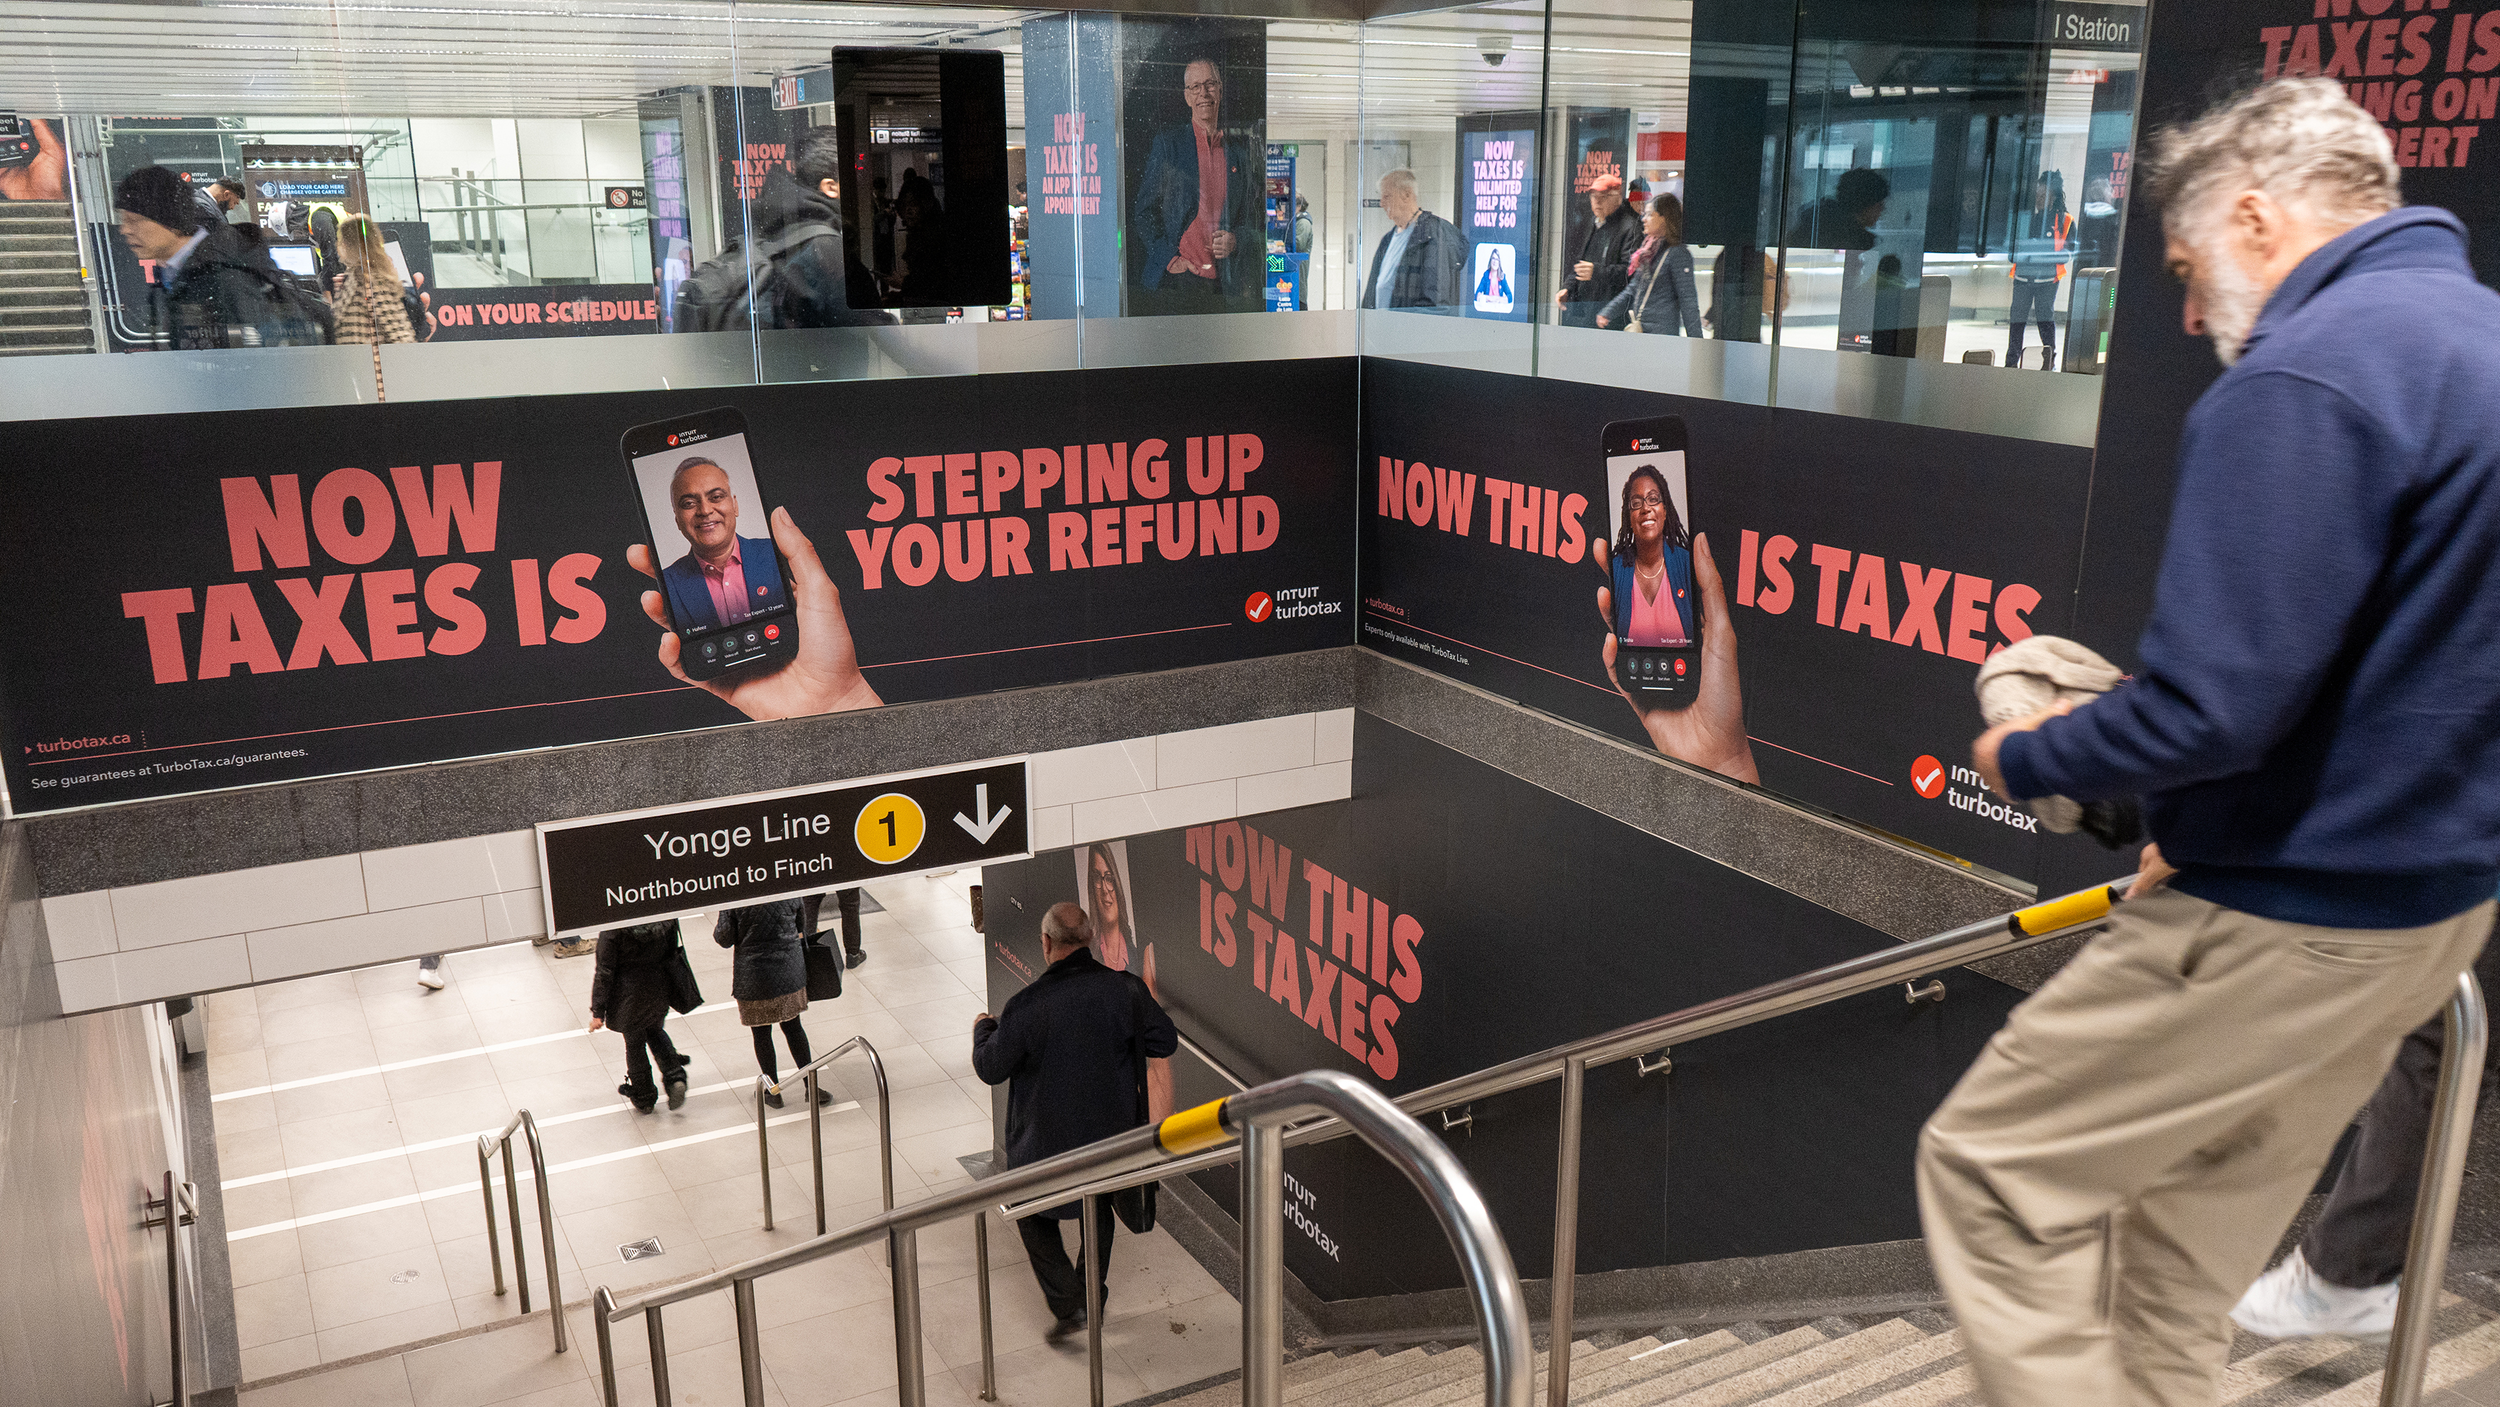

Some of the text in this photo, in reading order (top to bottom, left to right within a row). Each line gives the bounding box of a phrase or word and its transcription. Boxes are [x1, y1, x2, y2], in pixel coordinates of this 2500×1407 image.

[2065, 14, 2129, 41] Station
[2260, 10, 2500, 82] TAXES IS
[780, 76, 797, 107] EXIT
[2432, 77, 2500, 121] ON
[746, 144, 786, 159] NOW
[1085, 143, 1098, 174] IS
[1484, 141, 1515, 160] NOW
[1586, 151, 1612, 164] NOW
[1043, 177, 1053, 194] AN
[1055, 177, 1070, 194] APP
[1089, 176, 1101, 194] AN
[1473, 160, 1524, 180] TAXES IS
[1577, 164, 1620, 177] TAXES IS
[631, 189, 643, 197] No
[1473, 181, 1522, 195] UNLIMITED
[1476, 196, 1517, 211] HELP FOR
[1474, 211, 1517, 228] ONLY $60
[438, 300, 657, 326] ON YOUR SCHEDULE
[680, 433, 708, 444] turbotax
[866, 433, 1264, 522] STEPPING UP
[220, 461, 502, 572] NOW
[1379, 456, 1588, 563] NOW THIS
[846, 495, 1280, 590] YOUR REFUND
[1277, 586, 1319, 600] INTUIT
[1370, 597, 1404, 616] turbotax.ca
[1736, 529, 2042, 665] IS TAXES
[121, 553, 606, 684] TAXES IS
[1276, 601, 1342, 620] turbotax
[1365, 623, 1384, 636] Experts
[1385, 630, 1396, 642] only
[1396, 635, 1418, 648] available
[1419, 642, 1431, 652] with
[1431, 645, 1456, 661] TurboTax
[37, 733, 131, 754] turbotax.ca
[31, 747, 309, 789] See guarantees at TurboTax.ca/guarantees.
[1948, 787, 2038, 833] turbotax
[644, 811, 897, 861] Yonge Line 1
[605, 853, 833, 907] Northbound to Finch
[1186, 820, 1424, 1003] NOW THIS
[999, 942, 1032, 978] turbotax.ca
[1199, 879, 1400, 1081] IS TAXES
